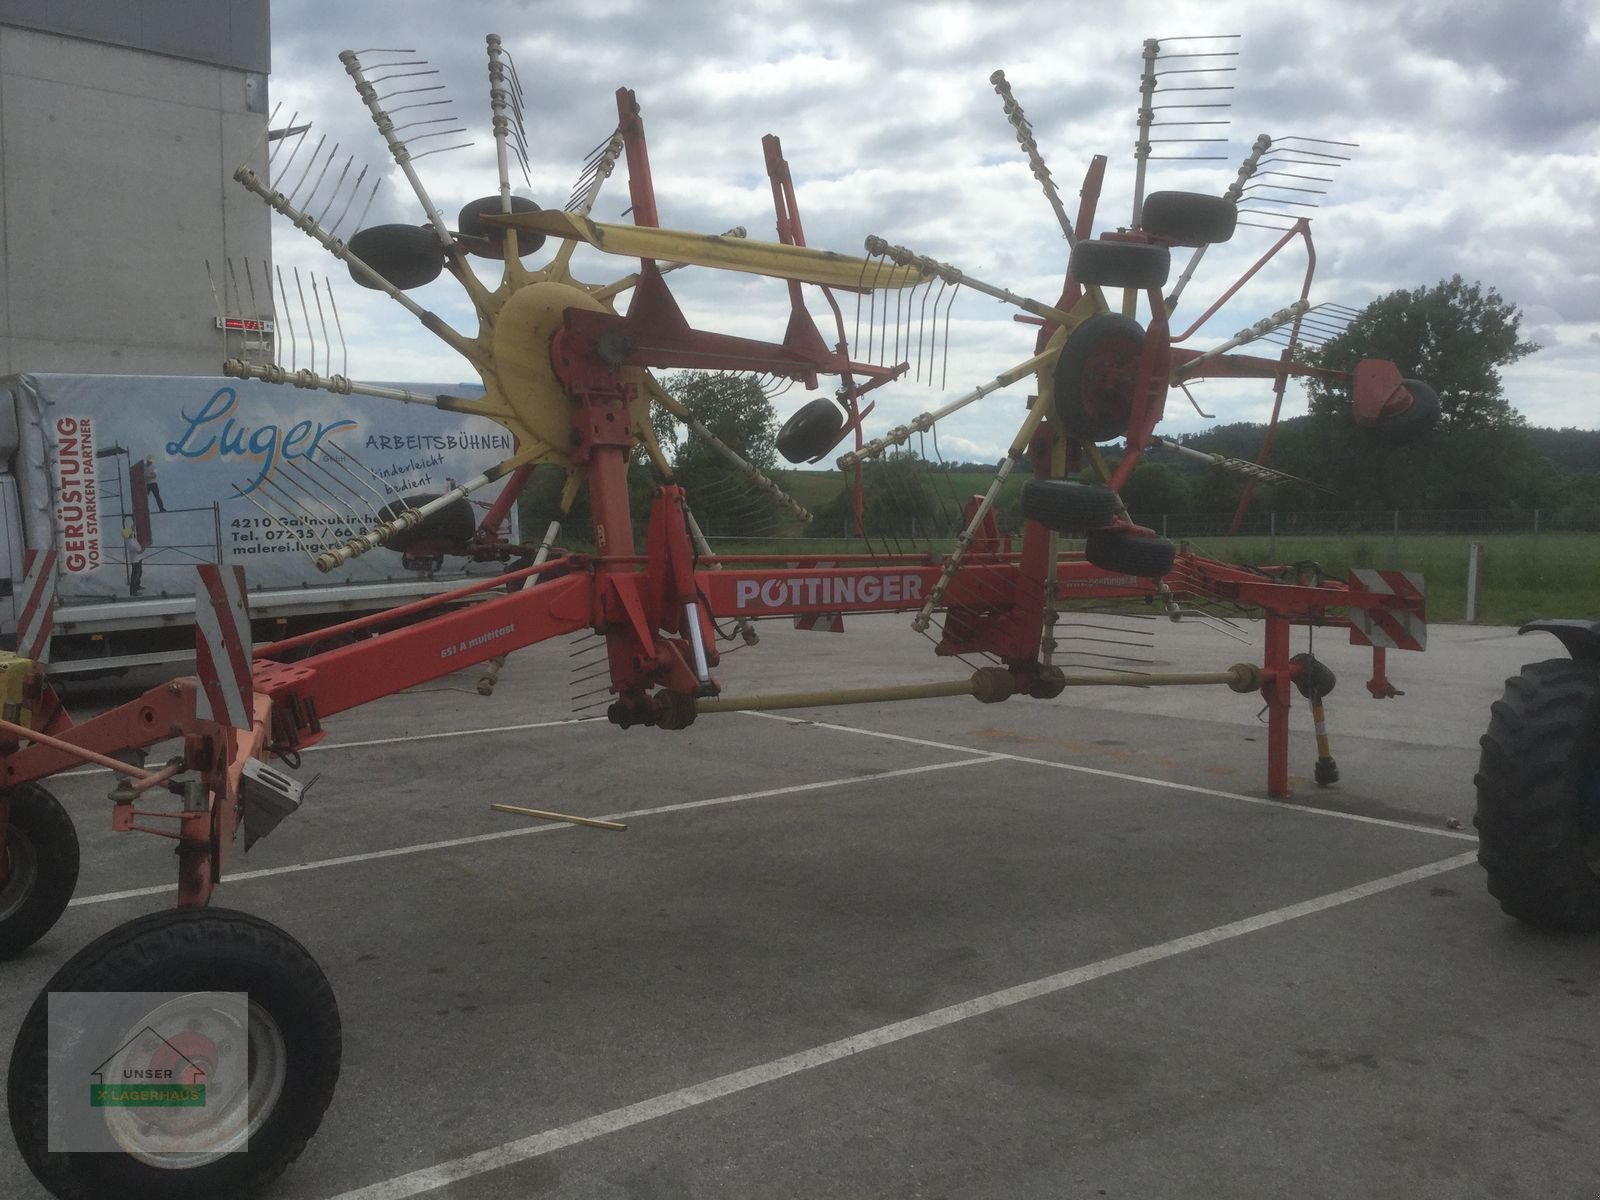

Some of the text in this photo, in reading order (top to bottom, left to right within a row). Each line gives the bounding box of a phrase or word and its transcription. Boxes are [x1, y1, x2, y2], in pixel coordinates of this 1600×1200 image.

[165, 386, 358, 500] Luger
[365, 431, 511, 451] ARBEITSBÜHNEN
[371, 452, 445, 481] kinderleicht
[56, 417, 86, 573] GERÜSTUNG
[80, 418, 101, 571] VOM STARKEN PARTNER
[384, 473, 433, 496] bedient
[231, 517, 272, 529] 4210
[231, 532, 259, 542] Tel.
[265, 528, 315, 541] 07235
[334, 526, 353, 538] 66
[736, 574, 922, 609] PÖTTINGER
